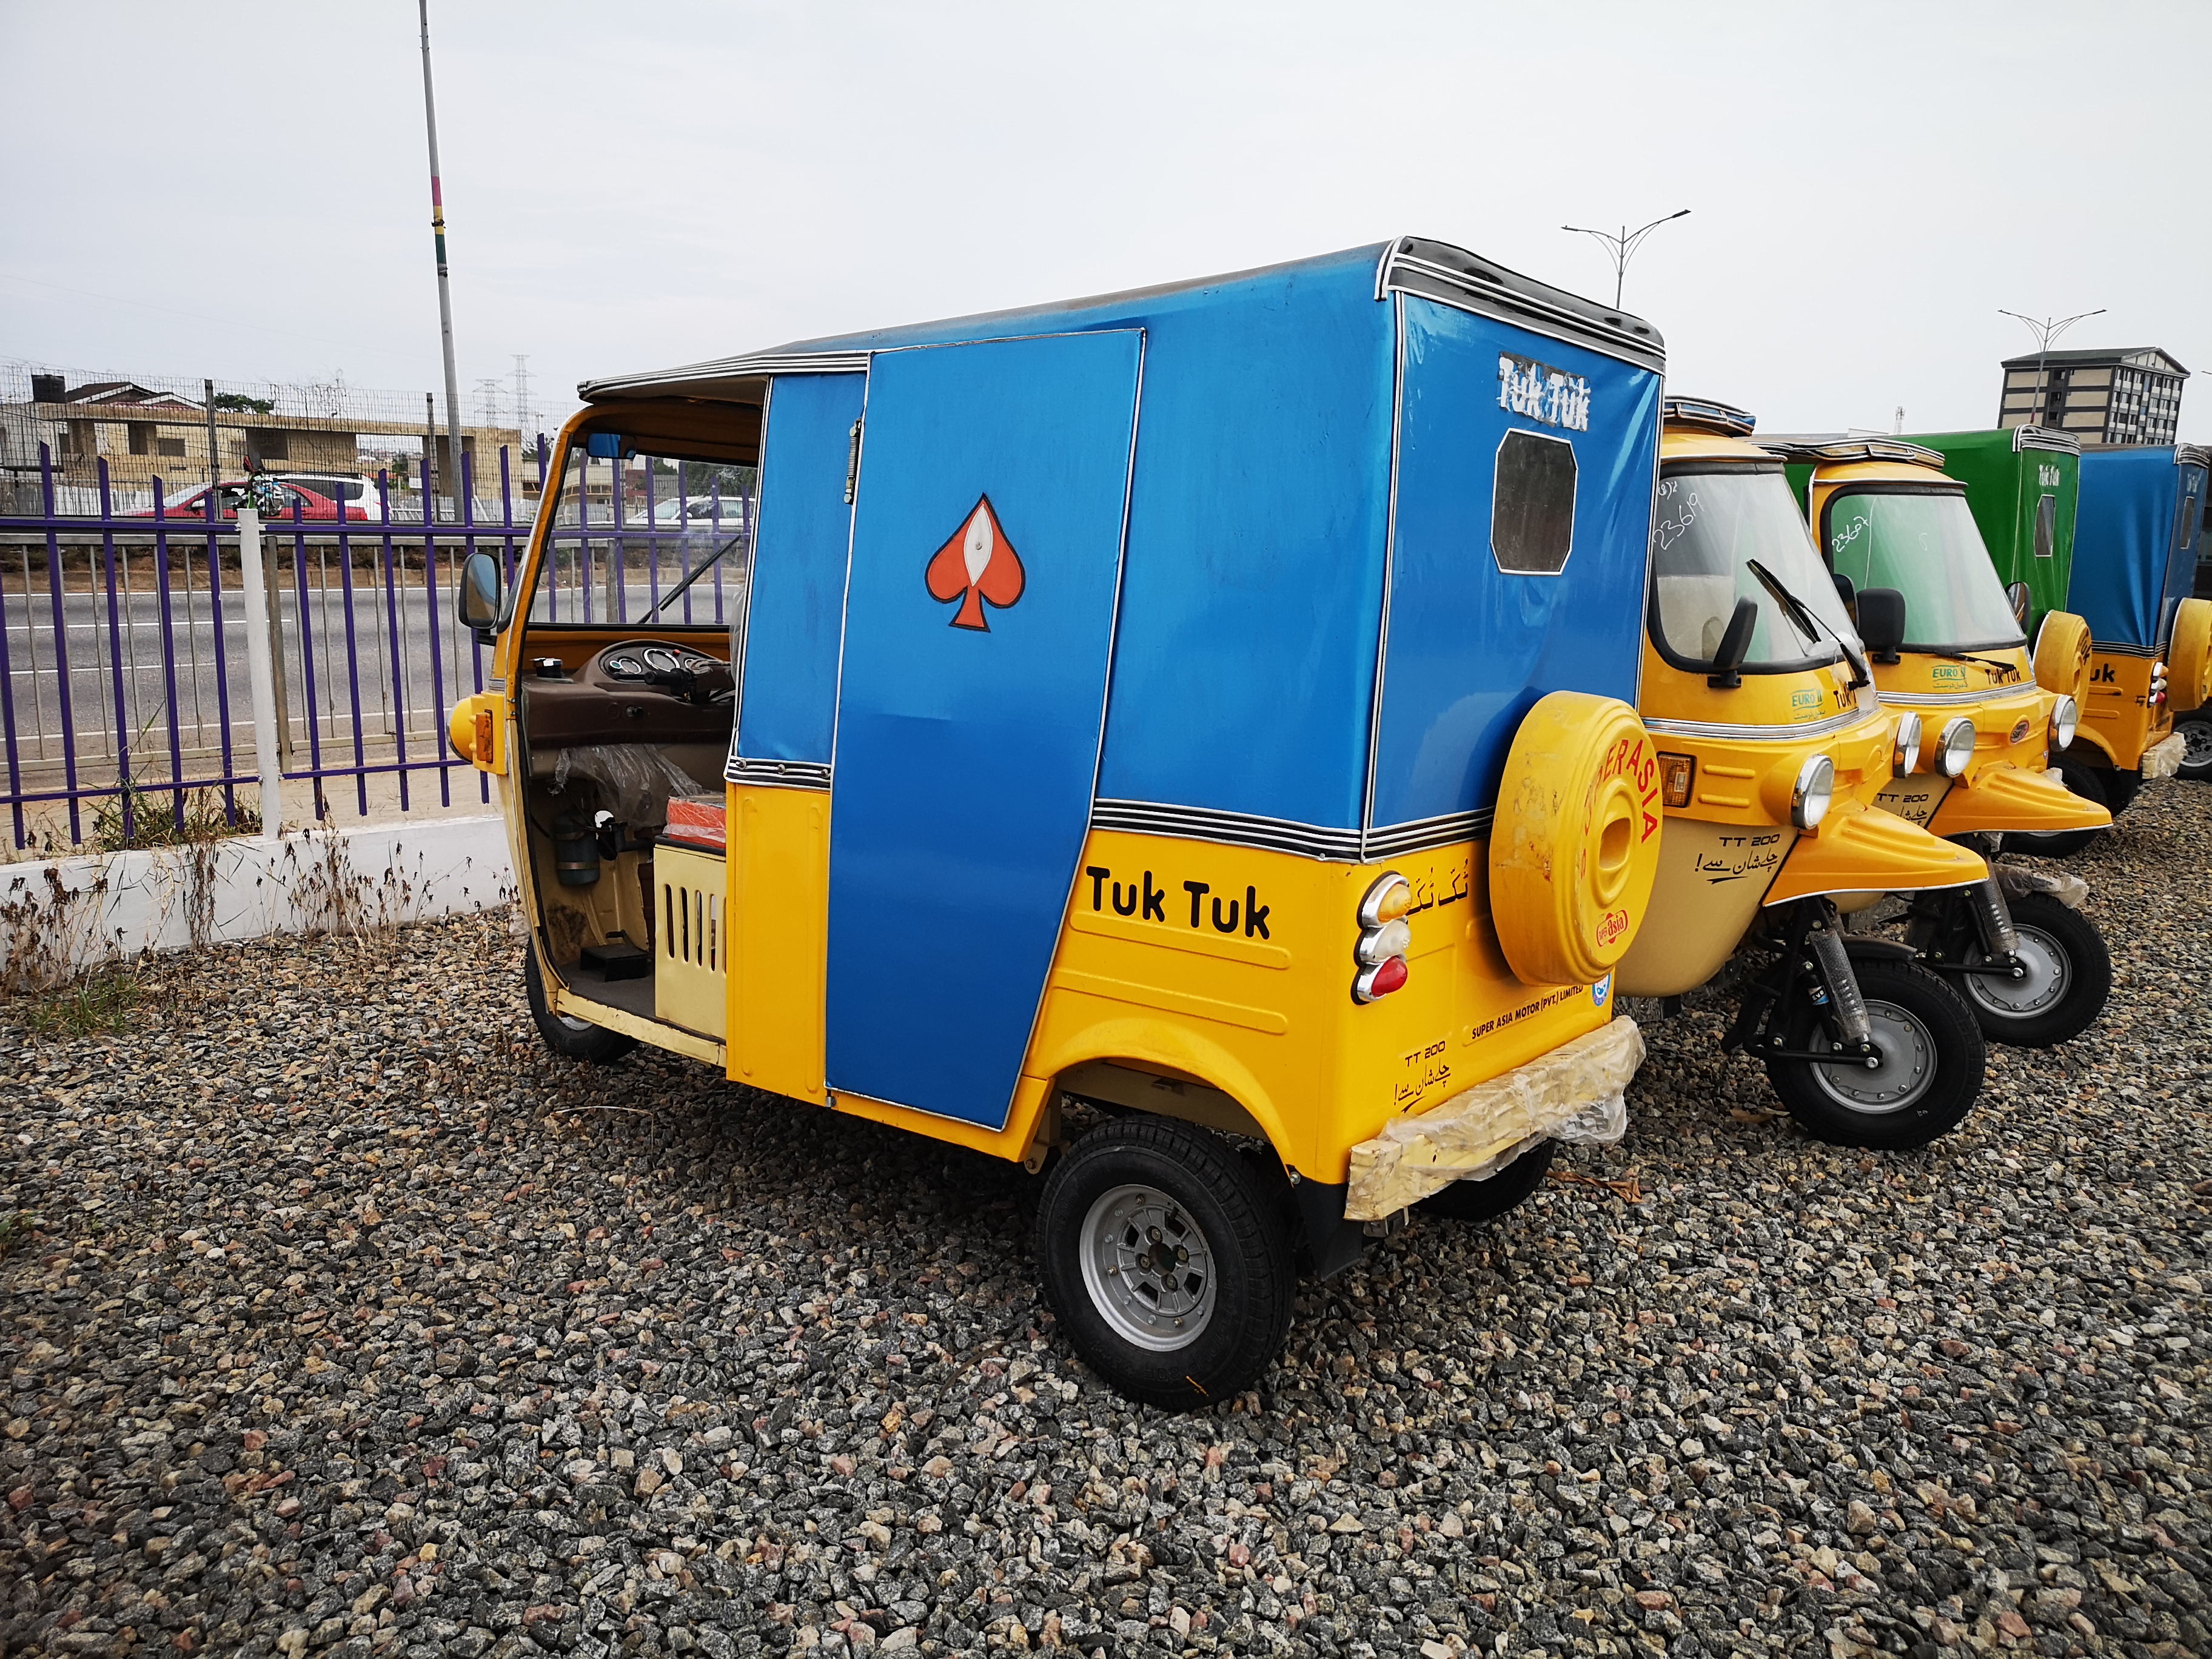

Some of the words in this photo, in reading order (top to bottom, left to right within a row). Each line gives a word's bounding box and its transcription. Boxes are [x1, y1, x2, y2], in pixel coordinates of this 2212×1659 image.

[1499, 357, 1542, 420] Tuk
[1550, 372, 1590, 432] Tuk
[1652, 492, 1704, 551] 23619
[1932, 668, 1957, 678] EURO
[1985, 668, 2003, 685] Tuk
[2090, 663, 2115, 683] uk
[1792, 694, 1815, 707] EURO
[1877, 793, 1899, 802] TT
[1903, 794, 1929, 803] 200
[1719, 837, 1747, 847] TT
[1751, 833, 1780, 846] 200
[1085, 865, 1165, 922] Tuk
[1183, 880, 1270, 940] Tuk
[1608, 914, 1624, 937] asia
[1472, 1020, 1494, 1040] SUPER
[1496, 1012, 1513, 1028] ASIA
[1515, 1001, 1540, 1021] MOTOR
[1541, 991, 1559, 1011] (PVT.)
[1560, 985, 1583, 1001] LIMITED
[1404, 1051, 1421, 1067] TT
[1424, 1040, 1446, 1060] 200
